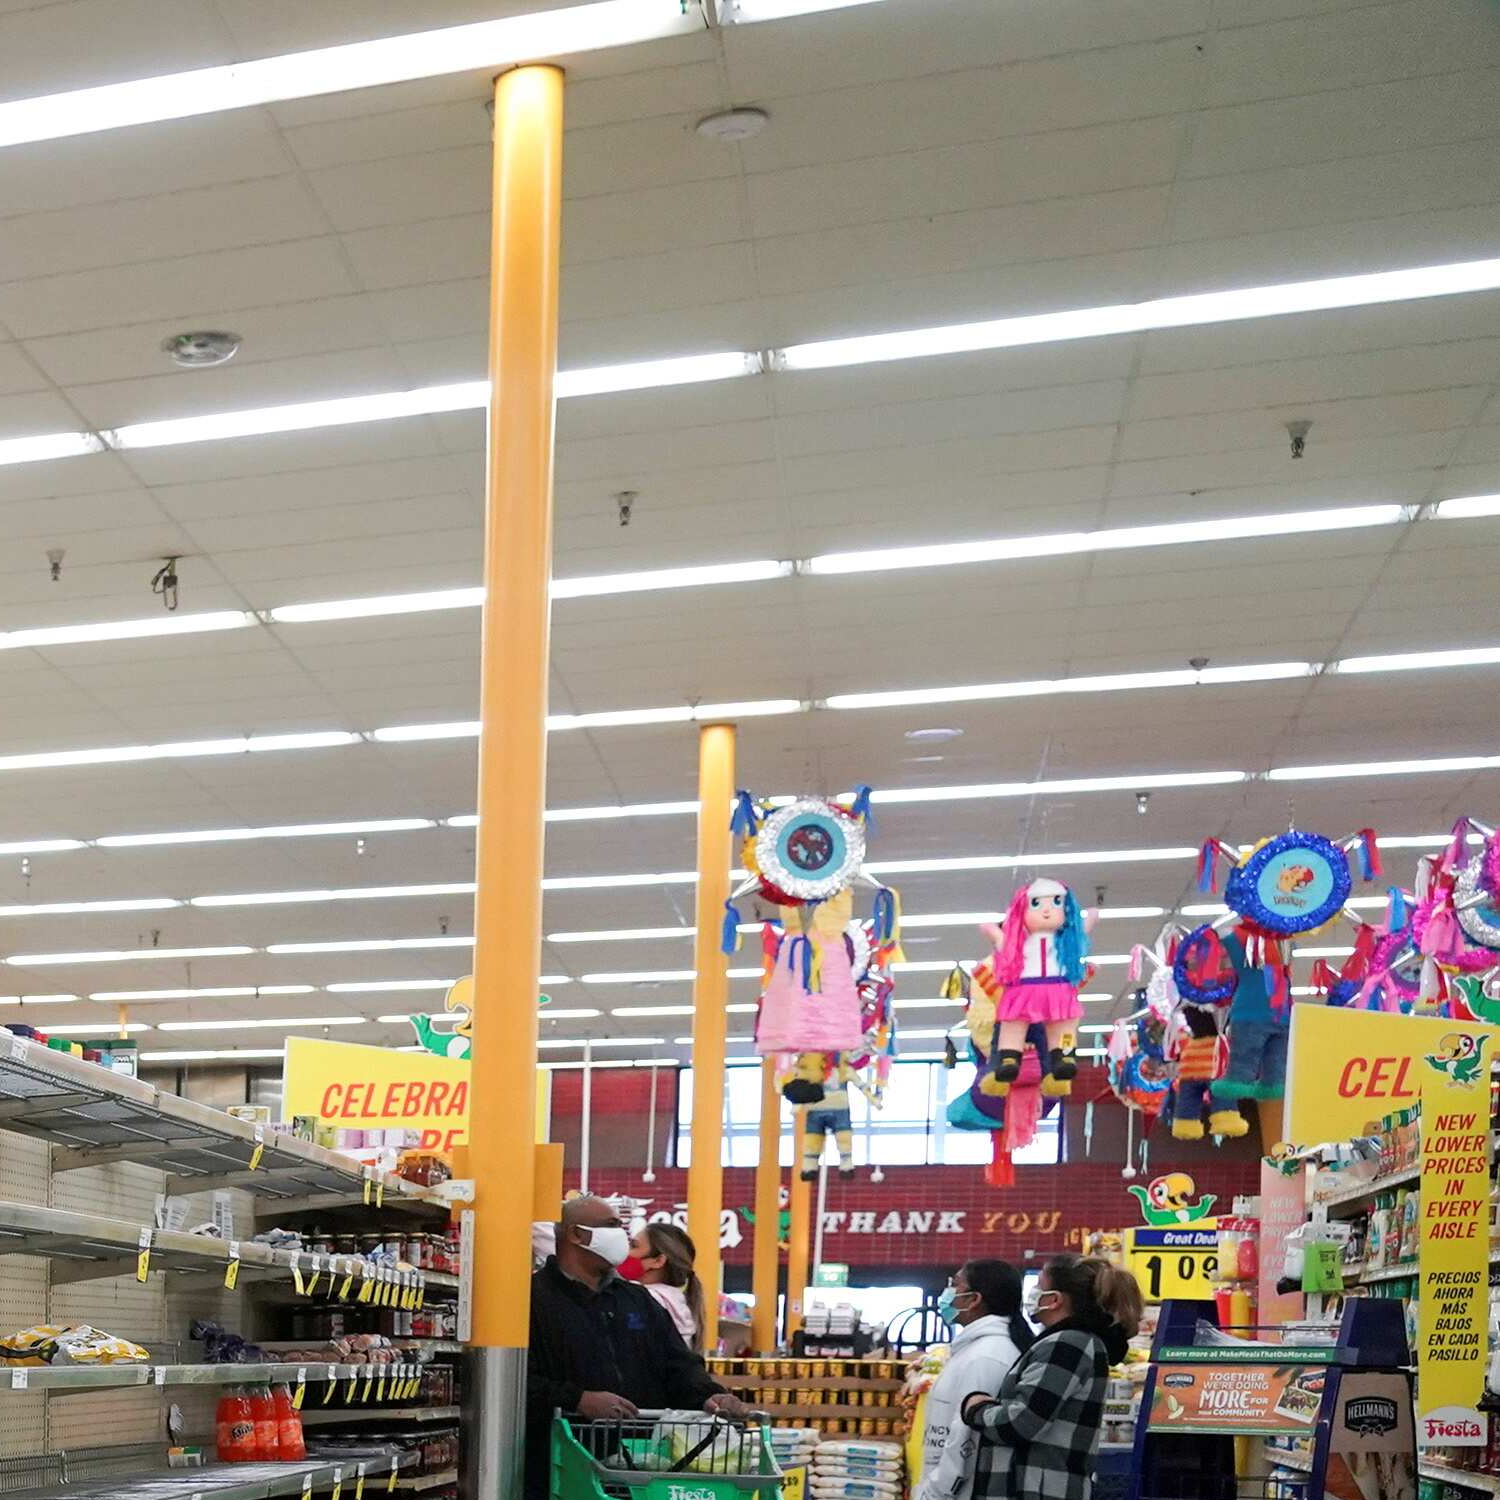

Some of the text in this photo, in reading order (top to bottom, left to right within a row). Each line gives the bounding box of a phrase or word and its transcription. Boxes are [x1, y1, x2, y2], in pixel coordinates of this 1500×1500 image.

[1337, 1056, 1422, 1099] CEL
[320, 1081, 468, 1119] CELEBRA
[1434, 1113, 1477, 1131] NEW
[1424, 1135, 1486, 1153] LOWER
[1424, 1156, 1487, 1174] PRICES
[1444, 1179, 1464, 1195] IN
[1426, 1200, 1483, 1217] EVERY
[822, 1211, 1062, 1234] THANK YOU
[1429, 1221, 1479, 1239] AISLE
[1163, 1232, 1193, 1245] Great
[1427, 1271, 1481, 1285] PRECIOS
[1433, 1287, 1474, 1300] AHORA
[1440, 1300, 1467, 1315] MÁS
[1435, 1318, 1473, 1330] BAJOS
[1428, 1333, 1480, 1346] EN CADA
[1166, 1350, 1187, 1358] Learn
[1210, 1350, 1218, 1358] at
[1219, 1350, 1326, 1359] MakeMealsThatDoMore.com
[1428, 1348, 1479, 1361] PASILLO
[1209, 1372, 1265, 1381] TOGETHER
[1203, 1381, 1269, 1391] WE'RE DOING
[1199, 1390, 1268, 1409] MORE FOR
[1213, 1409, 1267, 1417] COMMUNITY
[1347, 1403, 1395, 1420] HELLMANN'S
[1424, 1419, 1482, 1440] Fiesta
